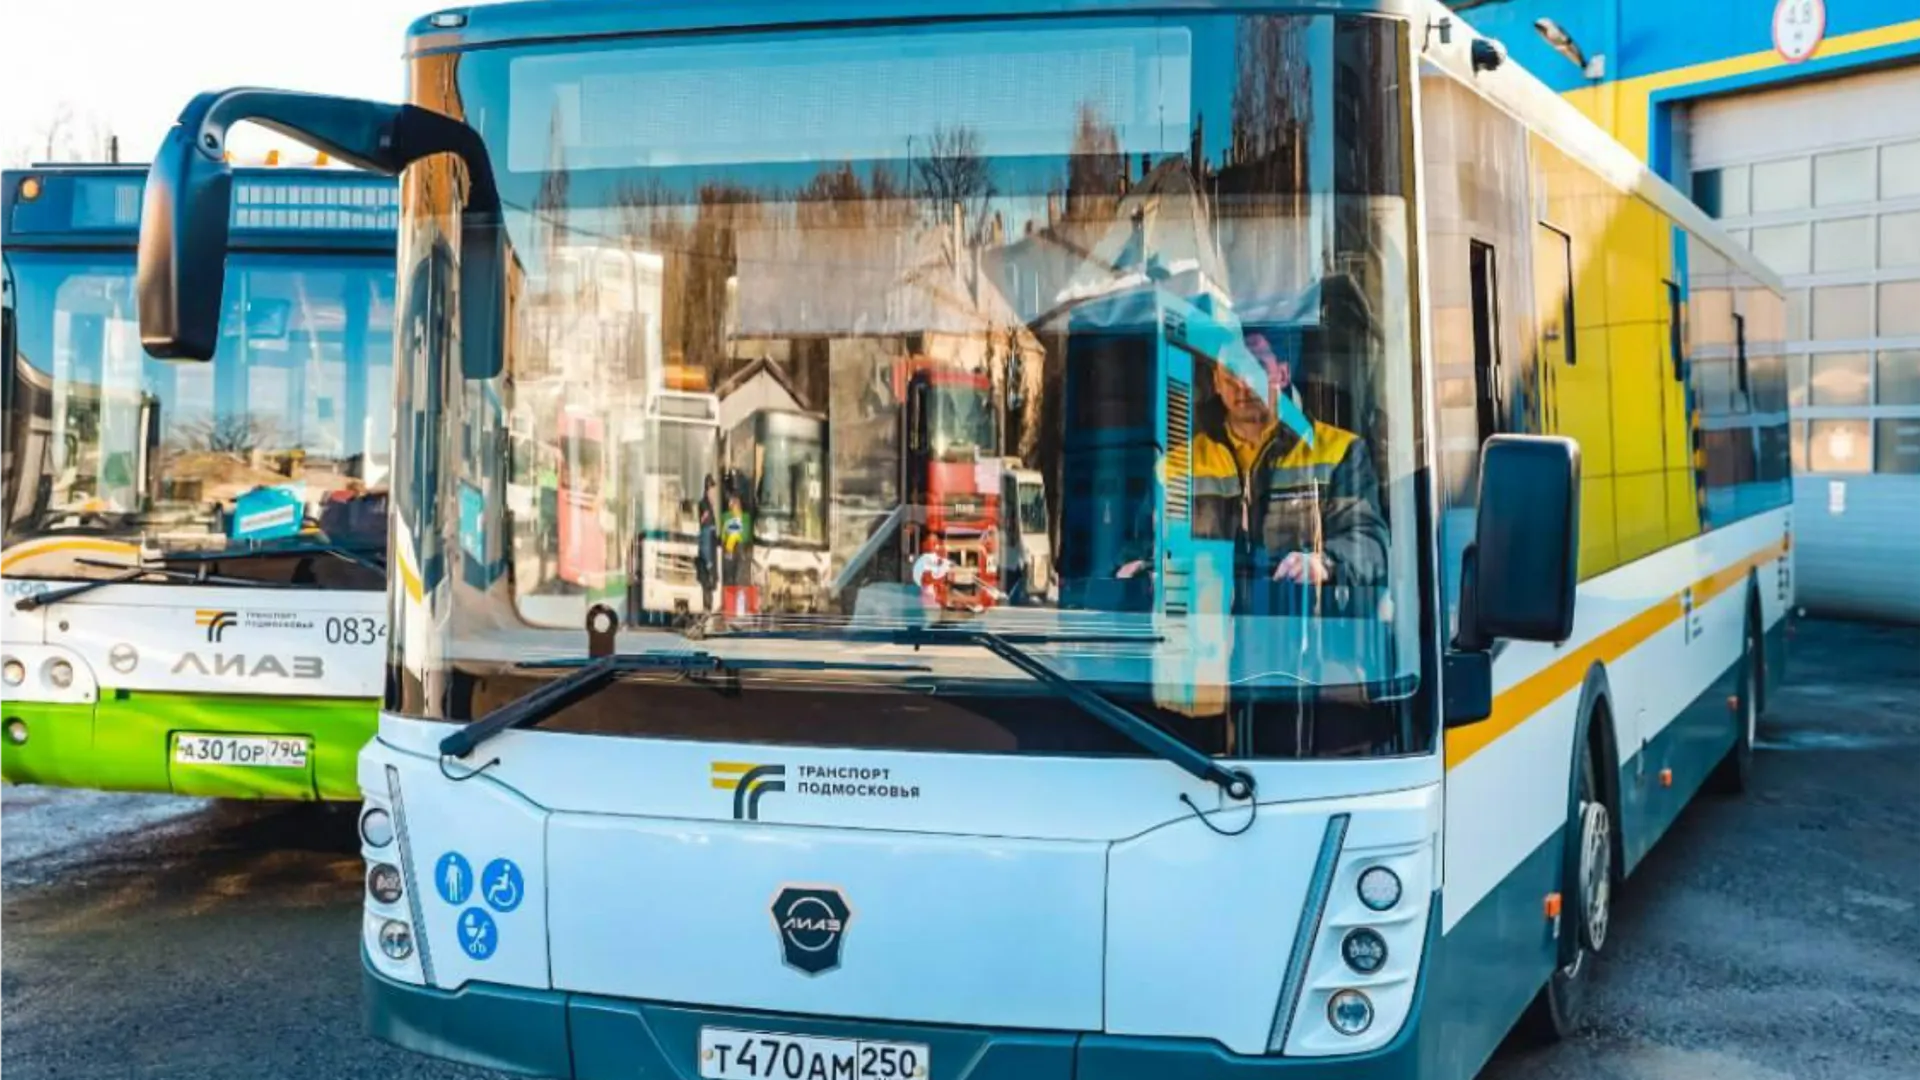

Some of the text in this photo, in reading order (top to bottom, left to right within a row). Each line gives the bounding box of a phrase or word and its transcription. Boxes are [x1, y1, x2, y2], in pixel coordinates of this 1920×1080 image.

[170, 652, 324, 680] ЛИАЗ
[798, 765, 890, 780] ТРАНСПОРТ
[798, 782, 920, 798] ПОДМОСКОВЬЯ
[783, 917, 841, 932] ЛИАЗ
[861, 1047, 917, 1078] 250
